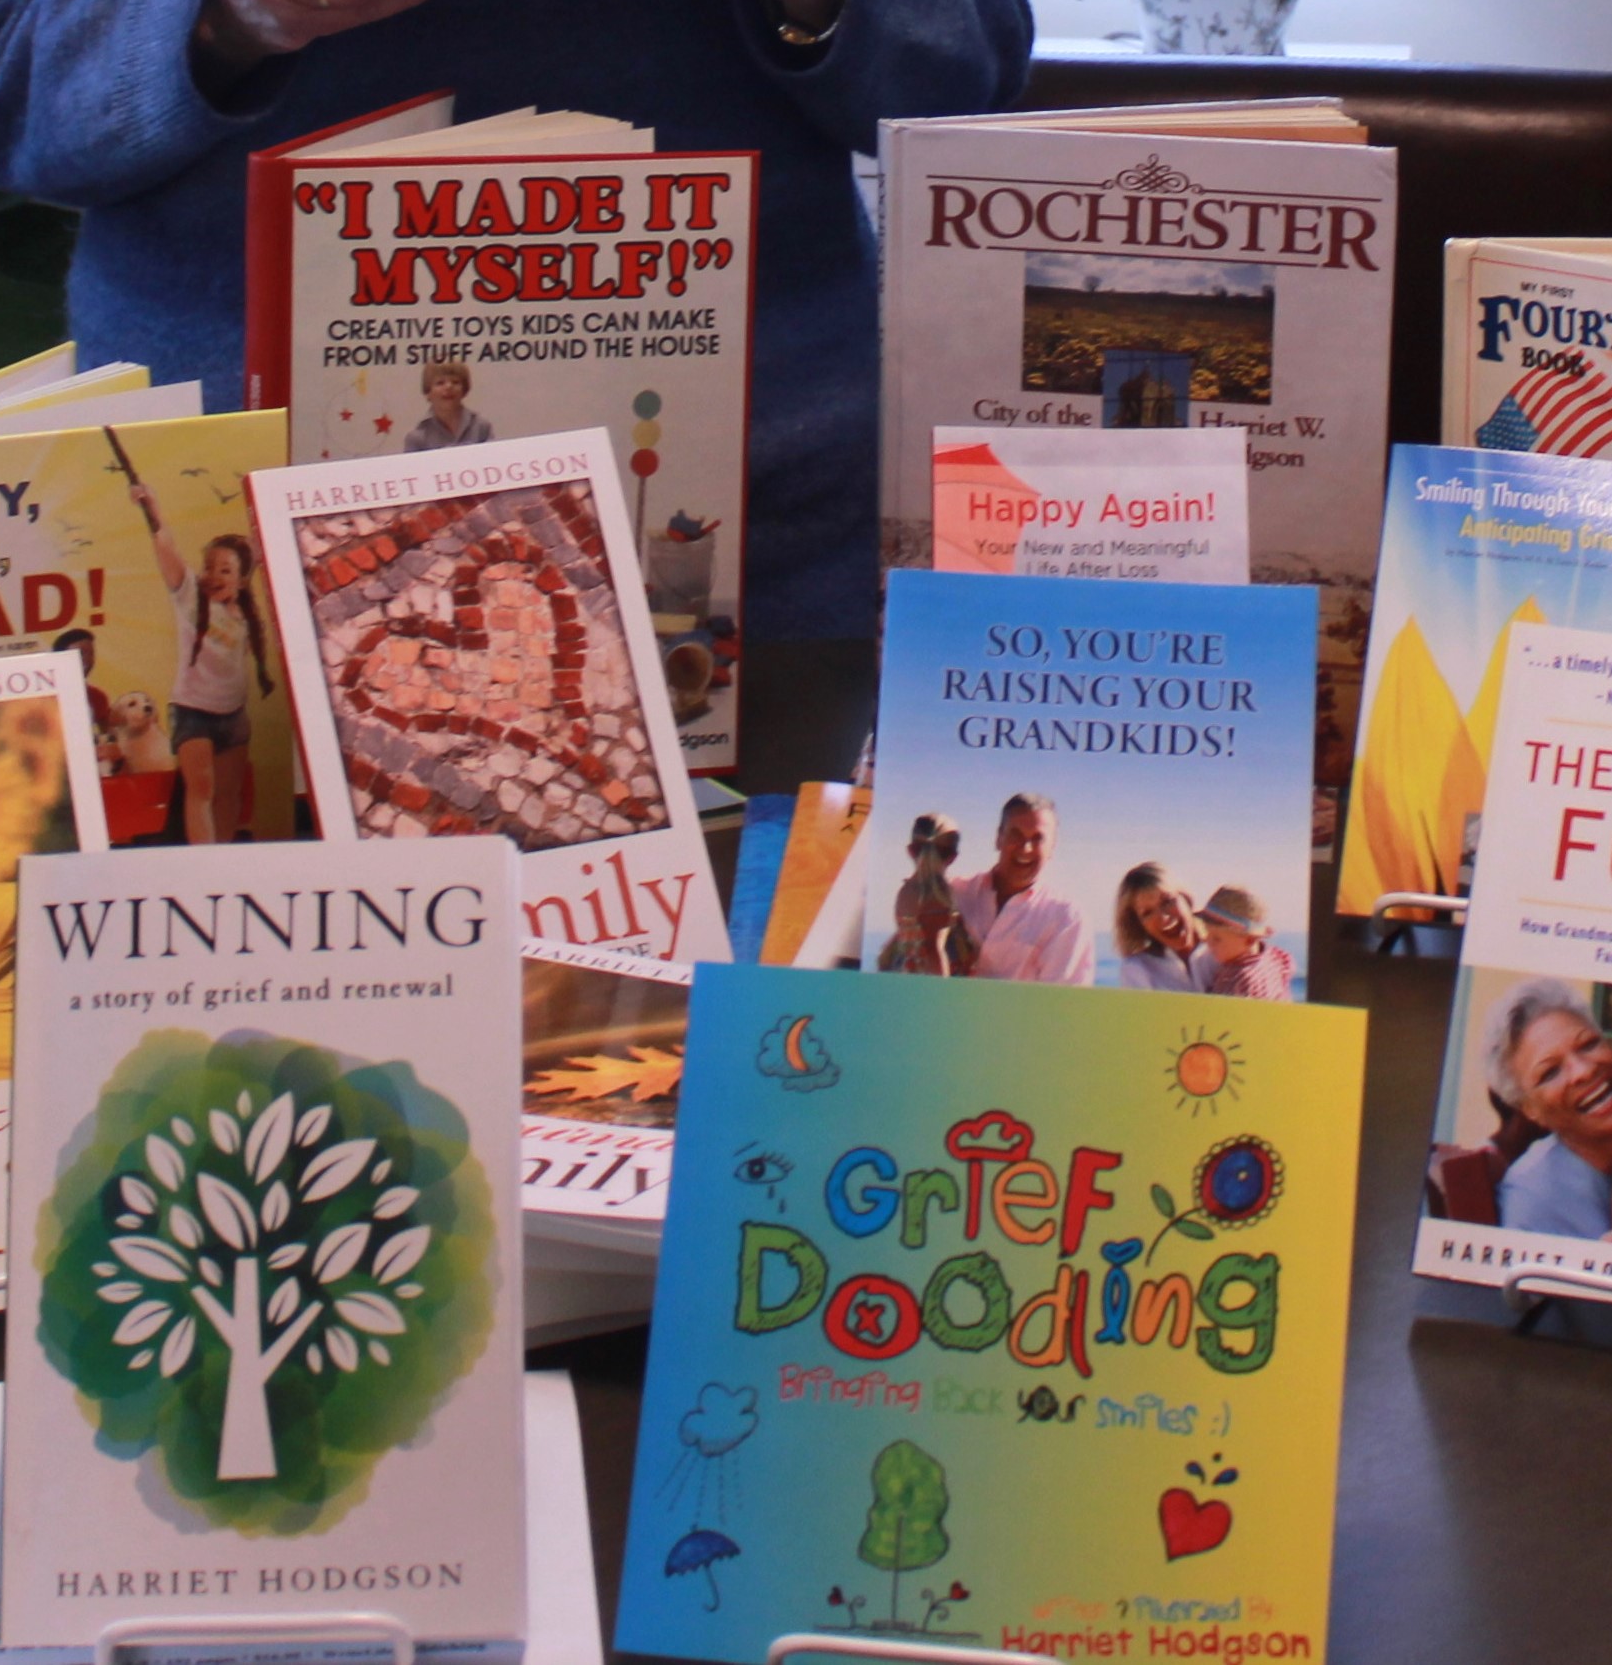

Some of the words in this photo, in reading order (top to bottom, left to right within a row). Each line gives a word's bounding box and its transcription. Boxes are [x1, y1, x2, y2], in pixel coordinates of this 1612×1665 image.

[394, 177, 624, 236] MADE
[645, 173, 730, 230] IT
[924, 185, 1380, 271] ROCHESTER
[351, 239, 733, 306] MYSELF!"
[1520, 282, 1537, 294] MY
[1541, 284, 1575, 299] FIRST
[327, 318, 443, 341] CREATIVE
[452, 315, 513, 337] TOYS
[522, 313, 574, 334] KIDS
[582, 311, 640, 333] CAN
[648, 309, 715, 330] MAKE
[324, 346, 396, 367] FROM
[406, 342, 473, 365] STUFF
[478, 339, 586, 362] AROUND
[594, 338, 633, 357] THE
[641, 335, 719, 356] HOUSE
[1521, 346, 1587, 378] BOOK
[972, 399, 1021, 427] City
[1025, 401, 1053, 425] of
[1056, 404, 1092, 426] the
[1294, 417, 1325, 438] W.
[287, 477, 419, 511] HARRIET
[435, 453, 589, 492] HODGSON
[1416, 476, 1486, 511] Smiling
[1491, 482, 1570, 517] Through
[969, 491, 1085, 528] Happy
[1098, 491, 1216, 528] Again!
[974, 539, 1018, 555] Your
[1023, 540, 1063, 555] New
[1070, 540, 1104, 555] and
[1110, 539, 1209, 558] Meaningful
[1459, 514, 1572, 553] Anticipating
[1065, 562, 1111, 577] After
[1118, 563, 1159, 578] Loss
[986, 625, 1051, 665] SO,
[1059, 628, 1225, 667] YOU'RE
[942, 668, 1120, 708] RAISING
[1131, 676, 1257, 713] YOUR
[678, 733, 729, 750] dgson
[958, 715, 1236, 758] GRANDKIDS!
[42, 885, 489, 962] WINNING
[521, 849, 696, 961] mily
[1520, 917, 1550, 935] How
[69, 992, 82, 1011] a
[92, 987, 155, 1015] story
[166, 983, 194, 1006] of
[204, 981, 272, 1011] grief
[280, 978, 331, 1002] and
[343, 974, 454, 1000] renewal
[778, 1364, 921, 1413] Bringing
[933, 1382, 1005, 1415] Back
[57, 1570, 238, 1599] HARRIET
[258, 1563, 467, 1596] HODGSON
[1000, 1625, 1133, 1657] Harriet
[1148, 1625, 1312, 1664] Hodgson
